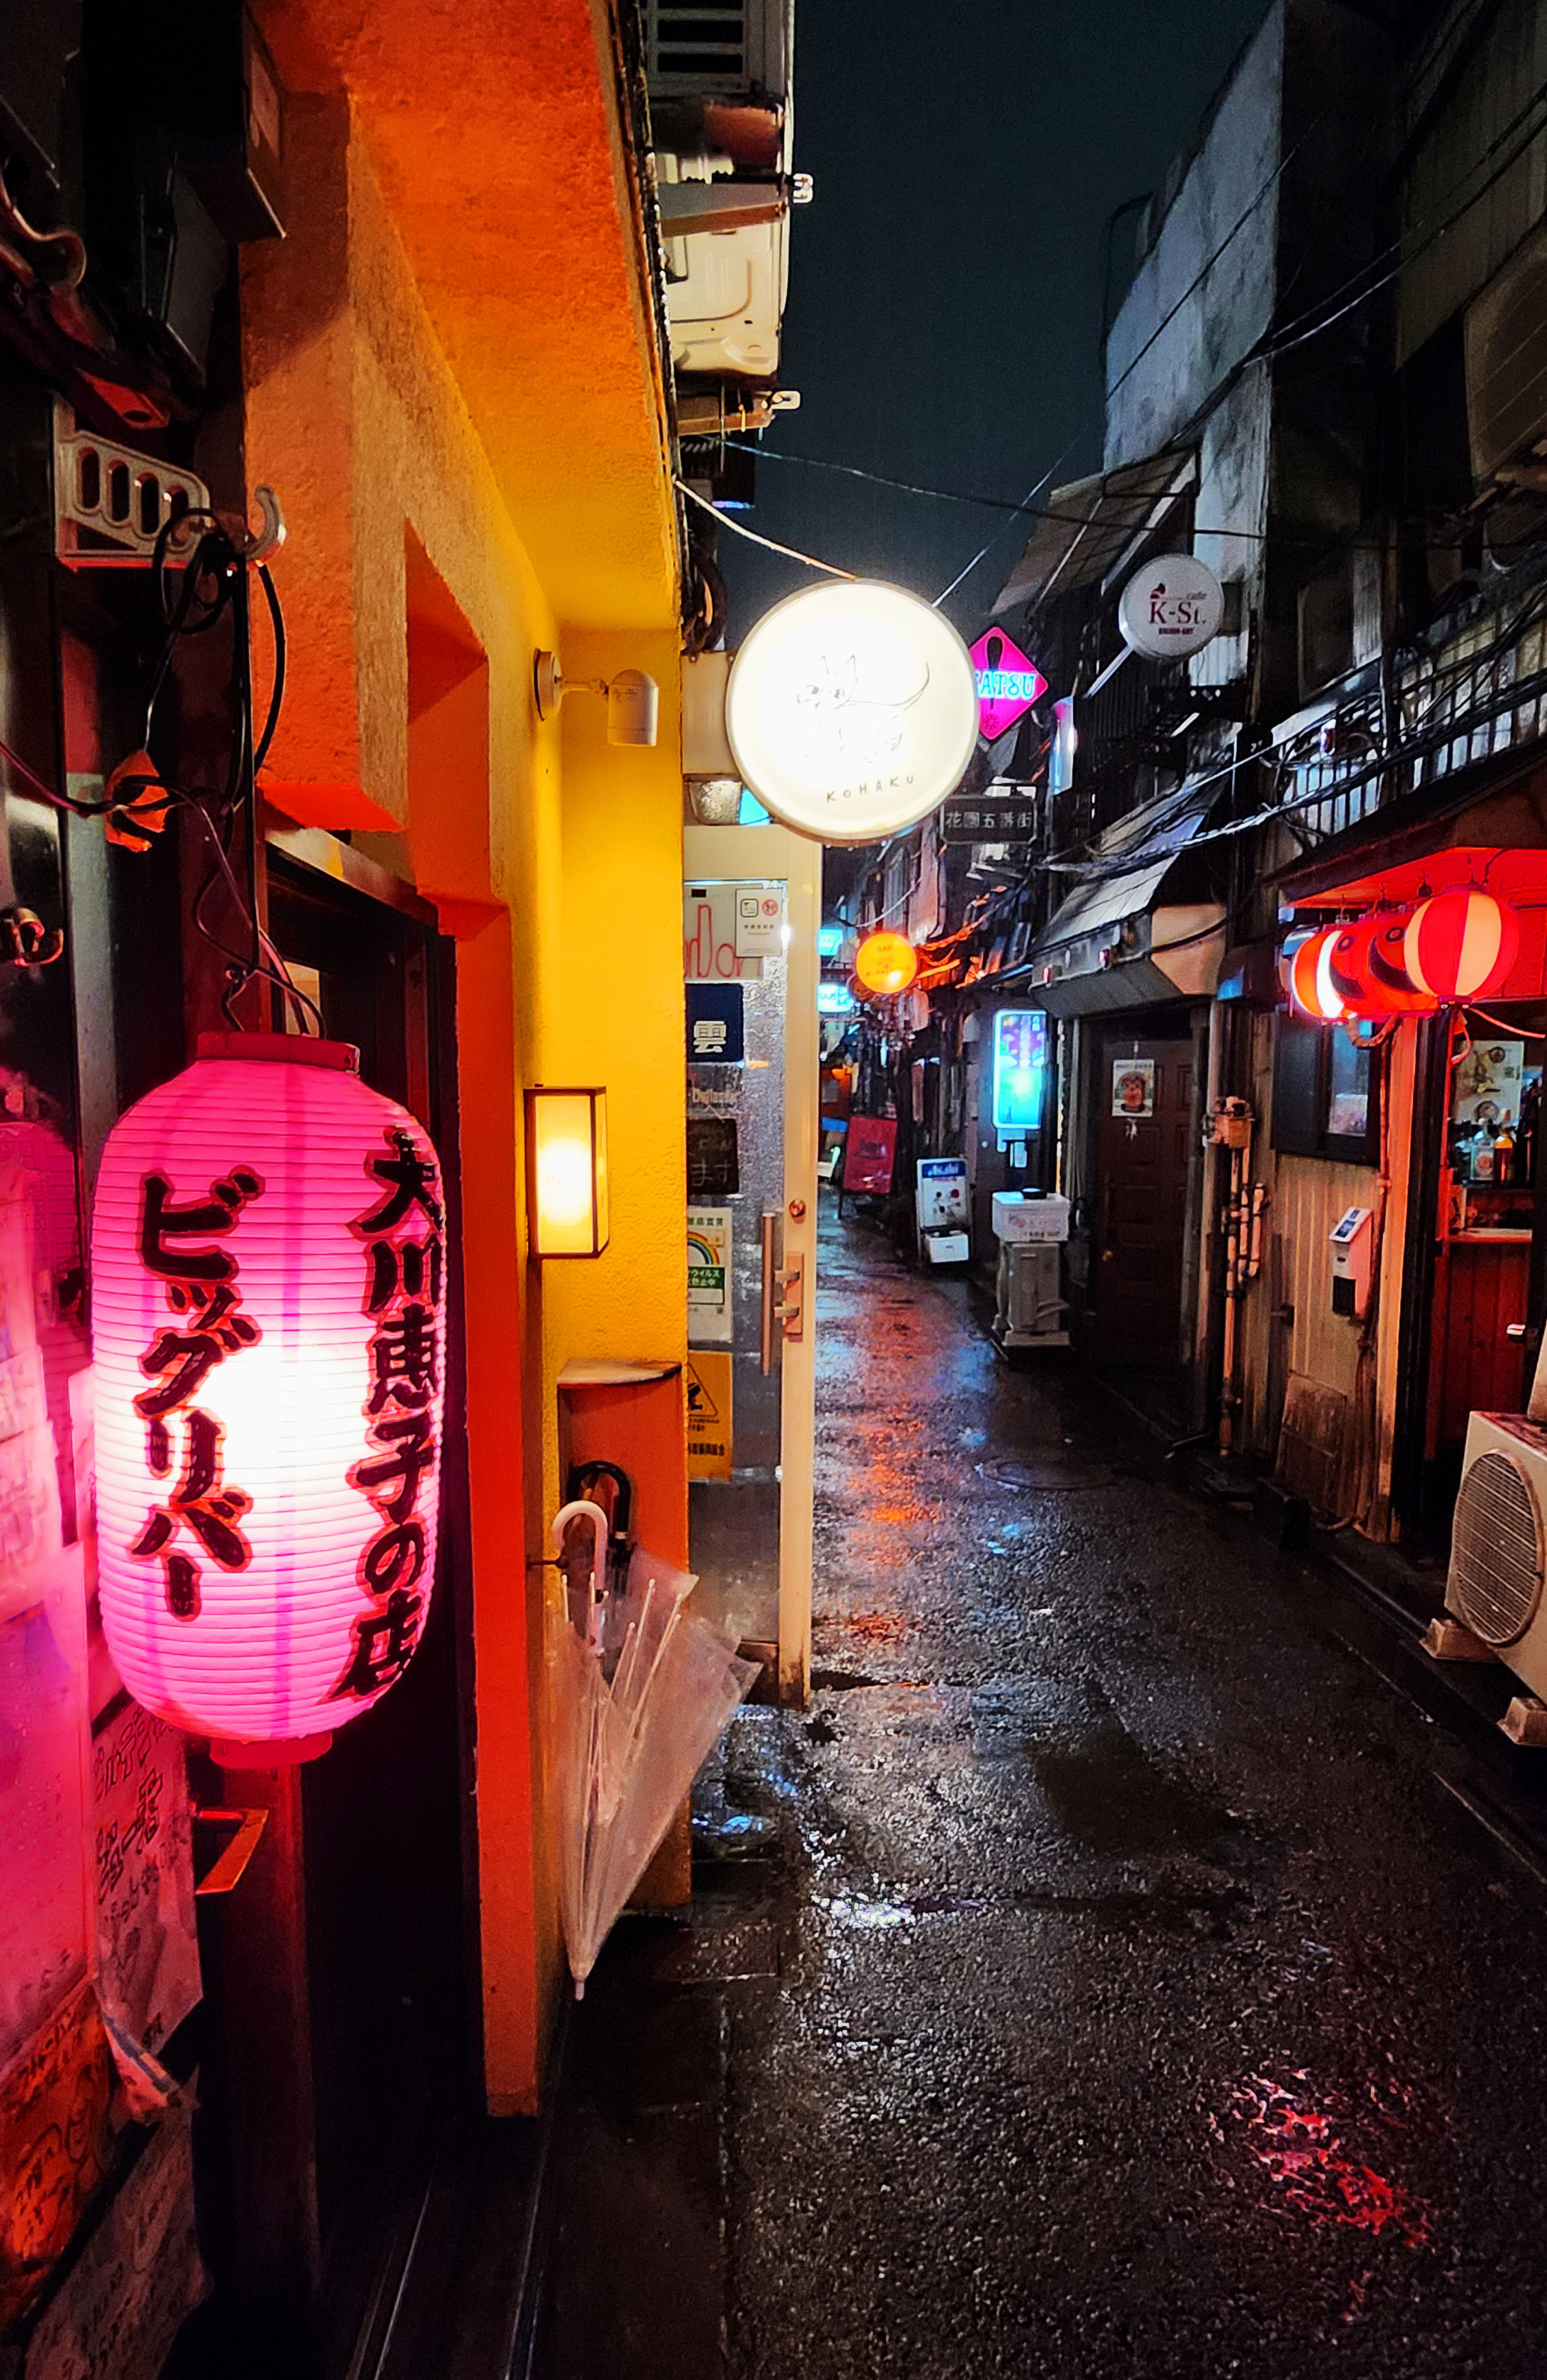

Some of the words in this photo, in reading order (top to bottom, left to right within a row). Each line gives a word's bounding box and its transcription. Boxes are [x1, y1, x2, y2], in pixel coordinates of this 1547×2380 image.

[826, 774, 916, 803] KOHAKU
[693, 1020, 727, 1053] 雲
[129, 1166, 264, 1620] ビッグリバー
